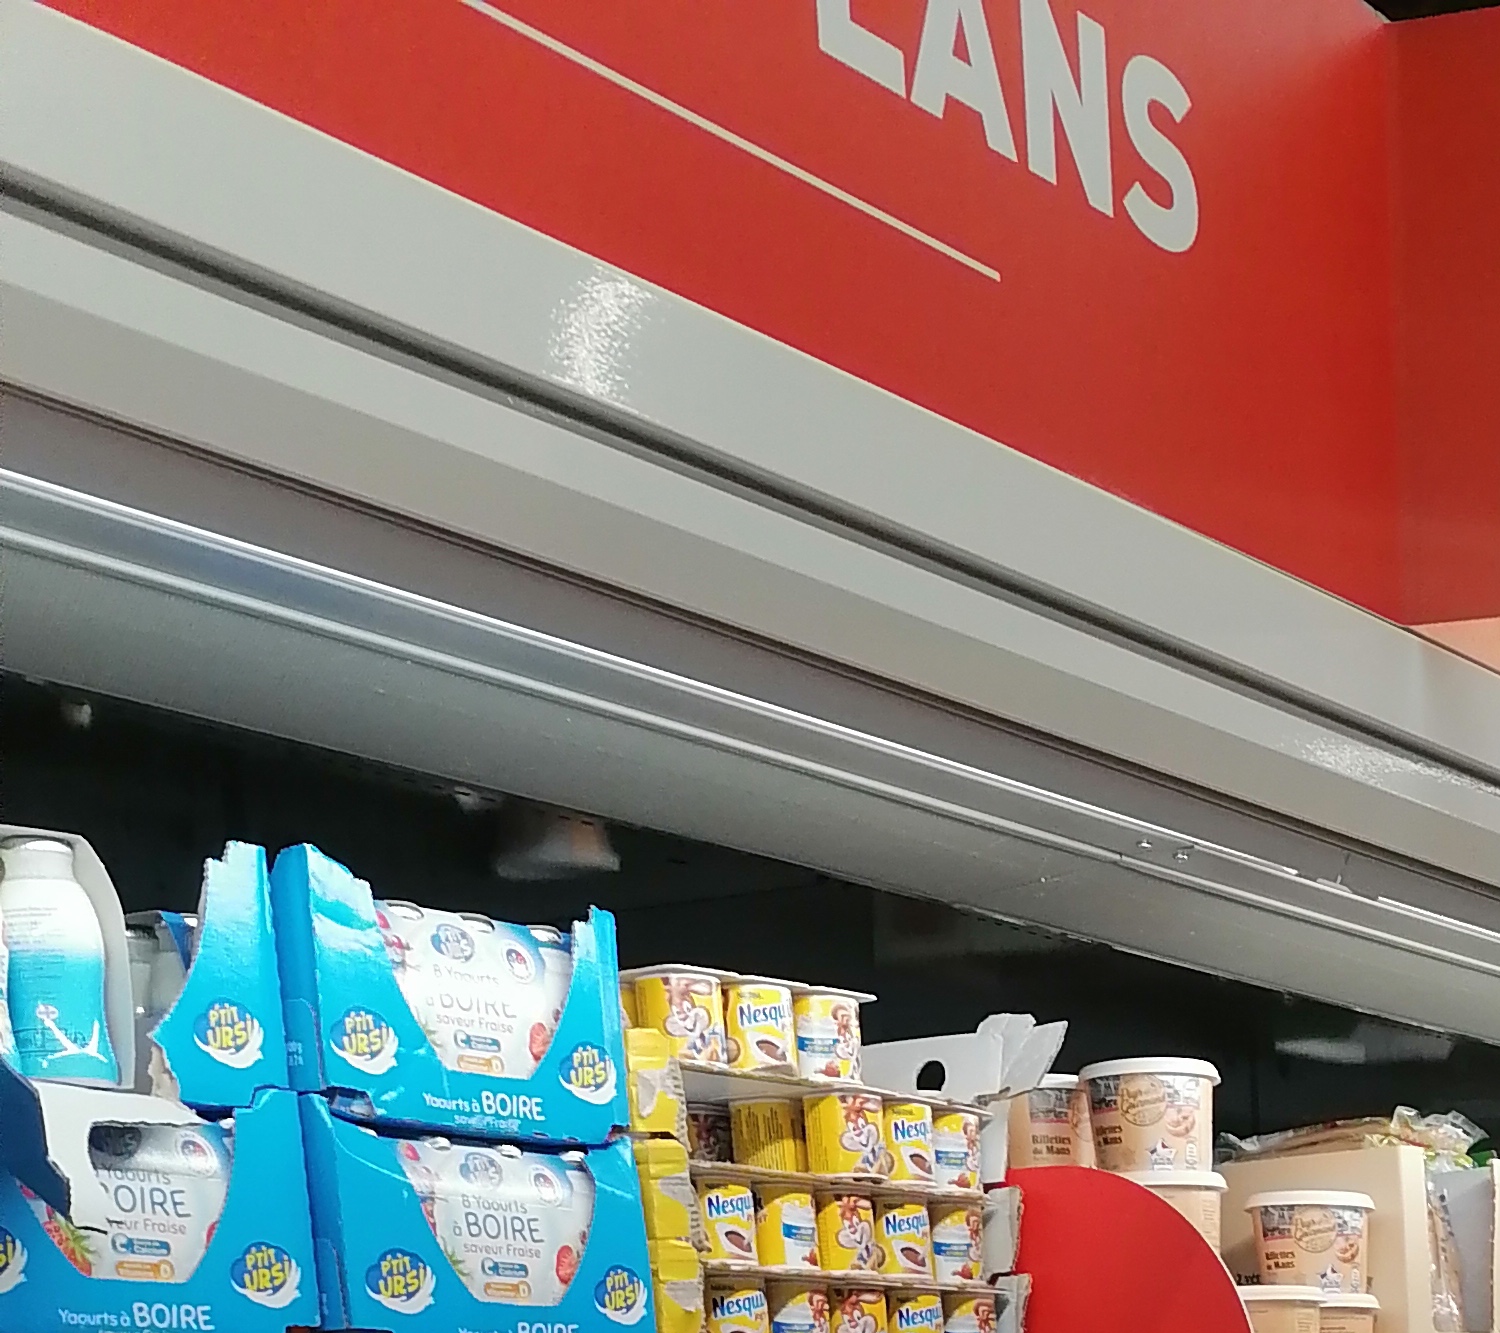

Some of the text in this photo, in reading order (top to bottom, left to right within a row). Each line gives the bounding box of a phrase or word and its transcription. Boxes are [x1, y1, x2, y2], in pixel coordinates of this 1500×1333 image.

[422, 1092, 470, 1113] Yaourts
[480, 1090, 546, 1122] BOIRE
[100, 1181, 193, 1218] OIRE
[142, 1218, 187, 1236] Fraise
[453, 1212, 545, 1244] à BOIRE
[463, 1243, 541, 1259] saveur Fraise
[58, 1301, 216, 1332] Yaourts à BOIRE
